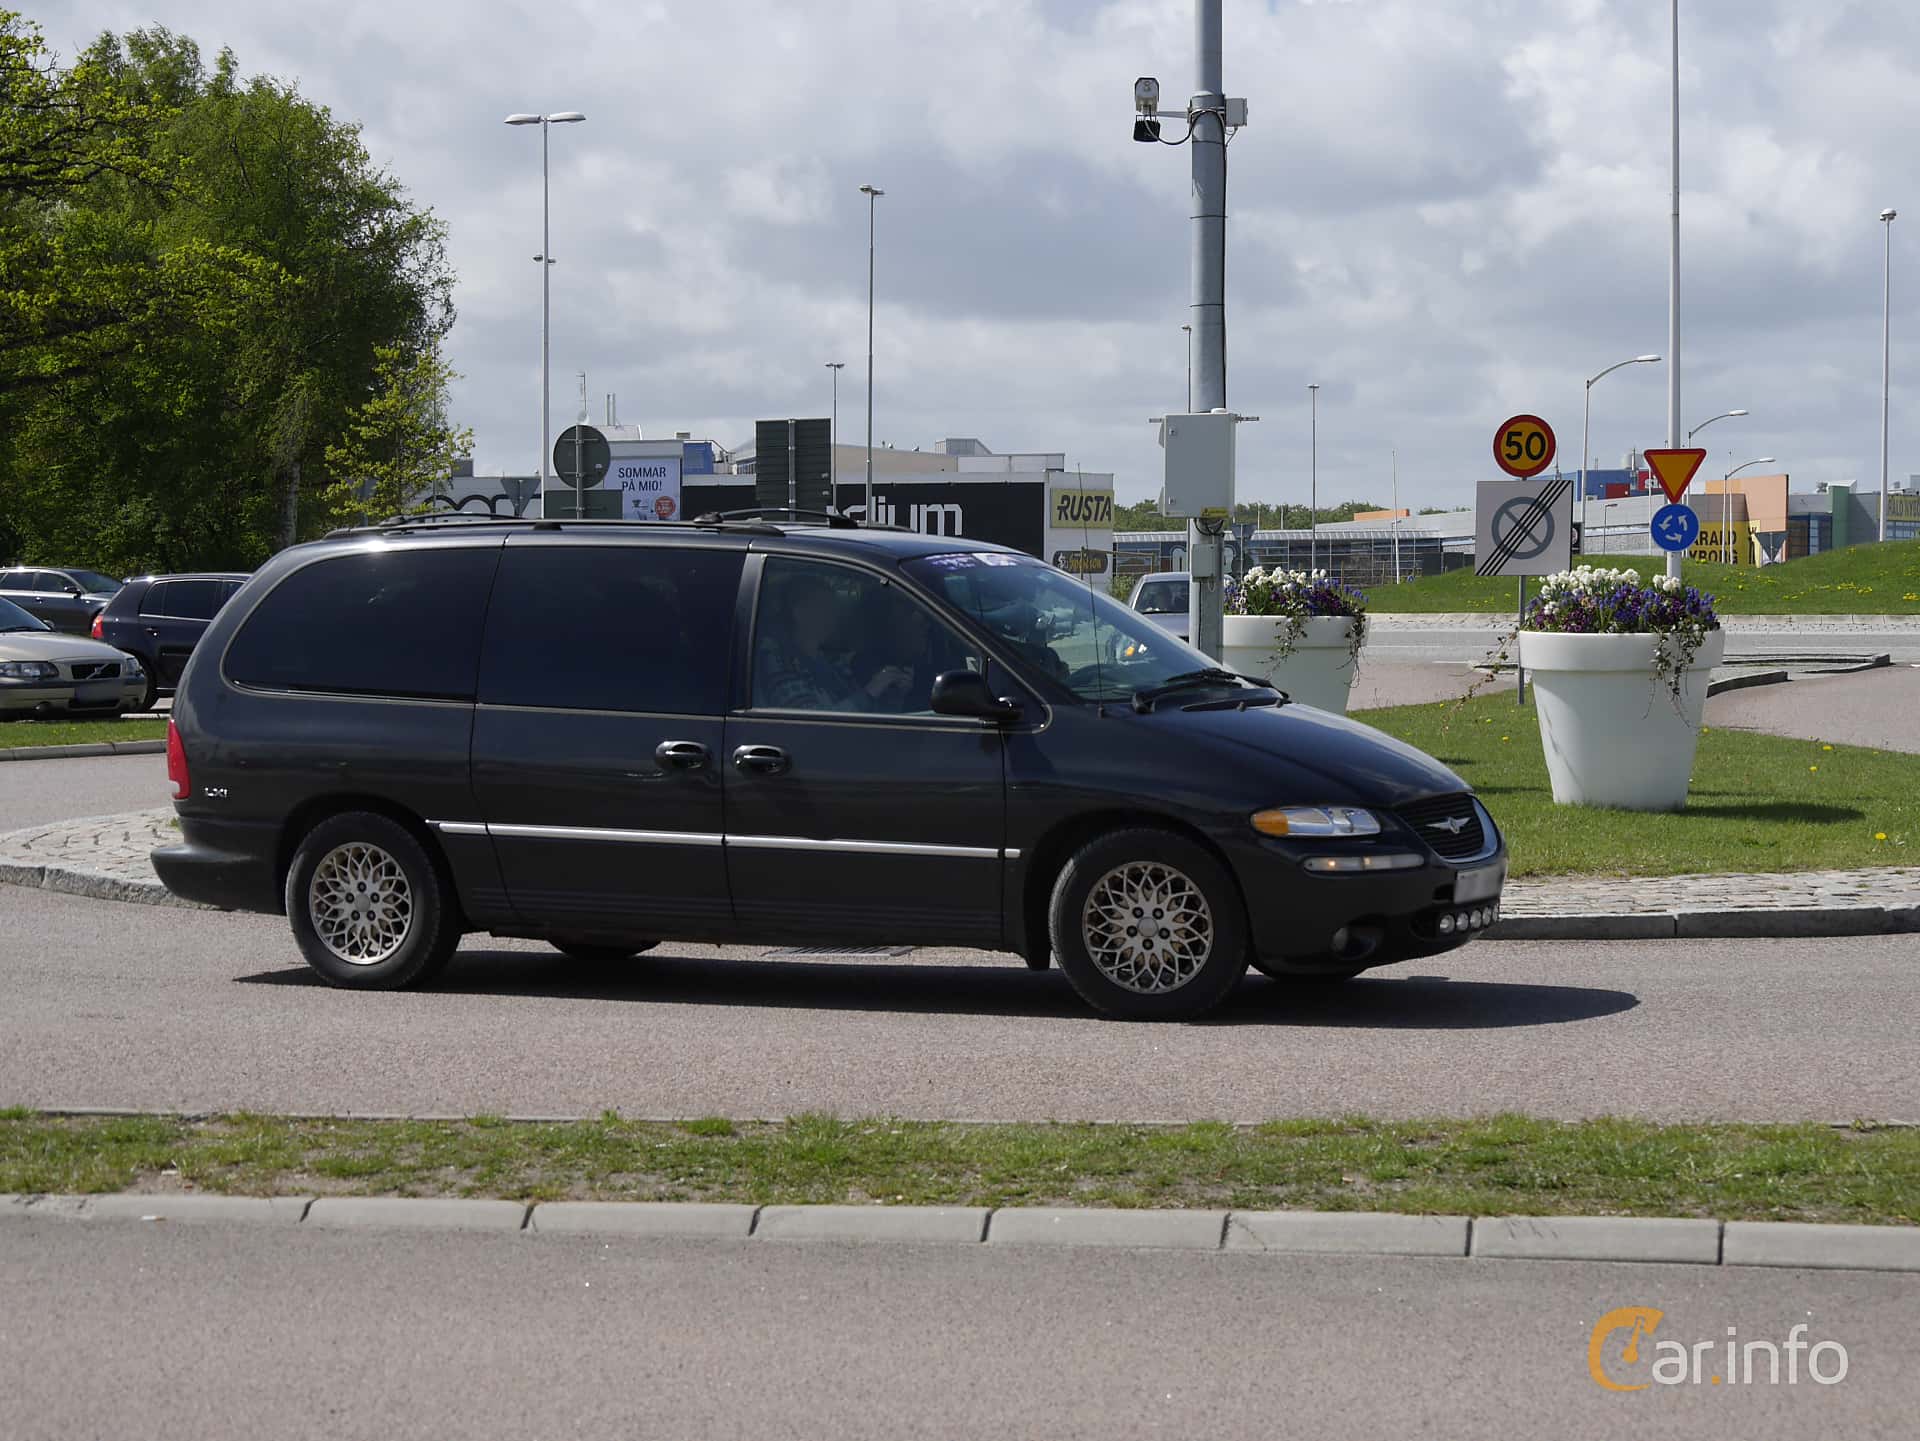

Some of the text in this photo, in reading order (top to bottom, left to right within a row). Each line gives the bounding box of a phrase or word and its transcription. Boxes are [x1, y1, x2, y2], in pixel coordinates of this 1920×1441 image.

[1505, 431, 1546, 461] 50
[618, 467, 666, 478] SOMMAR
[622, 479, 662, 491] PÅ MIO!
[1057, 494, 1112, 522] RUSTA
[1694, 530, 1737, 545] RALD
